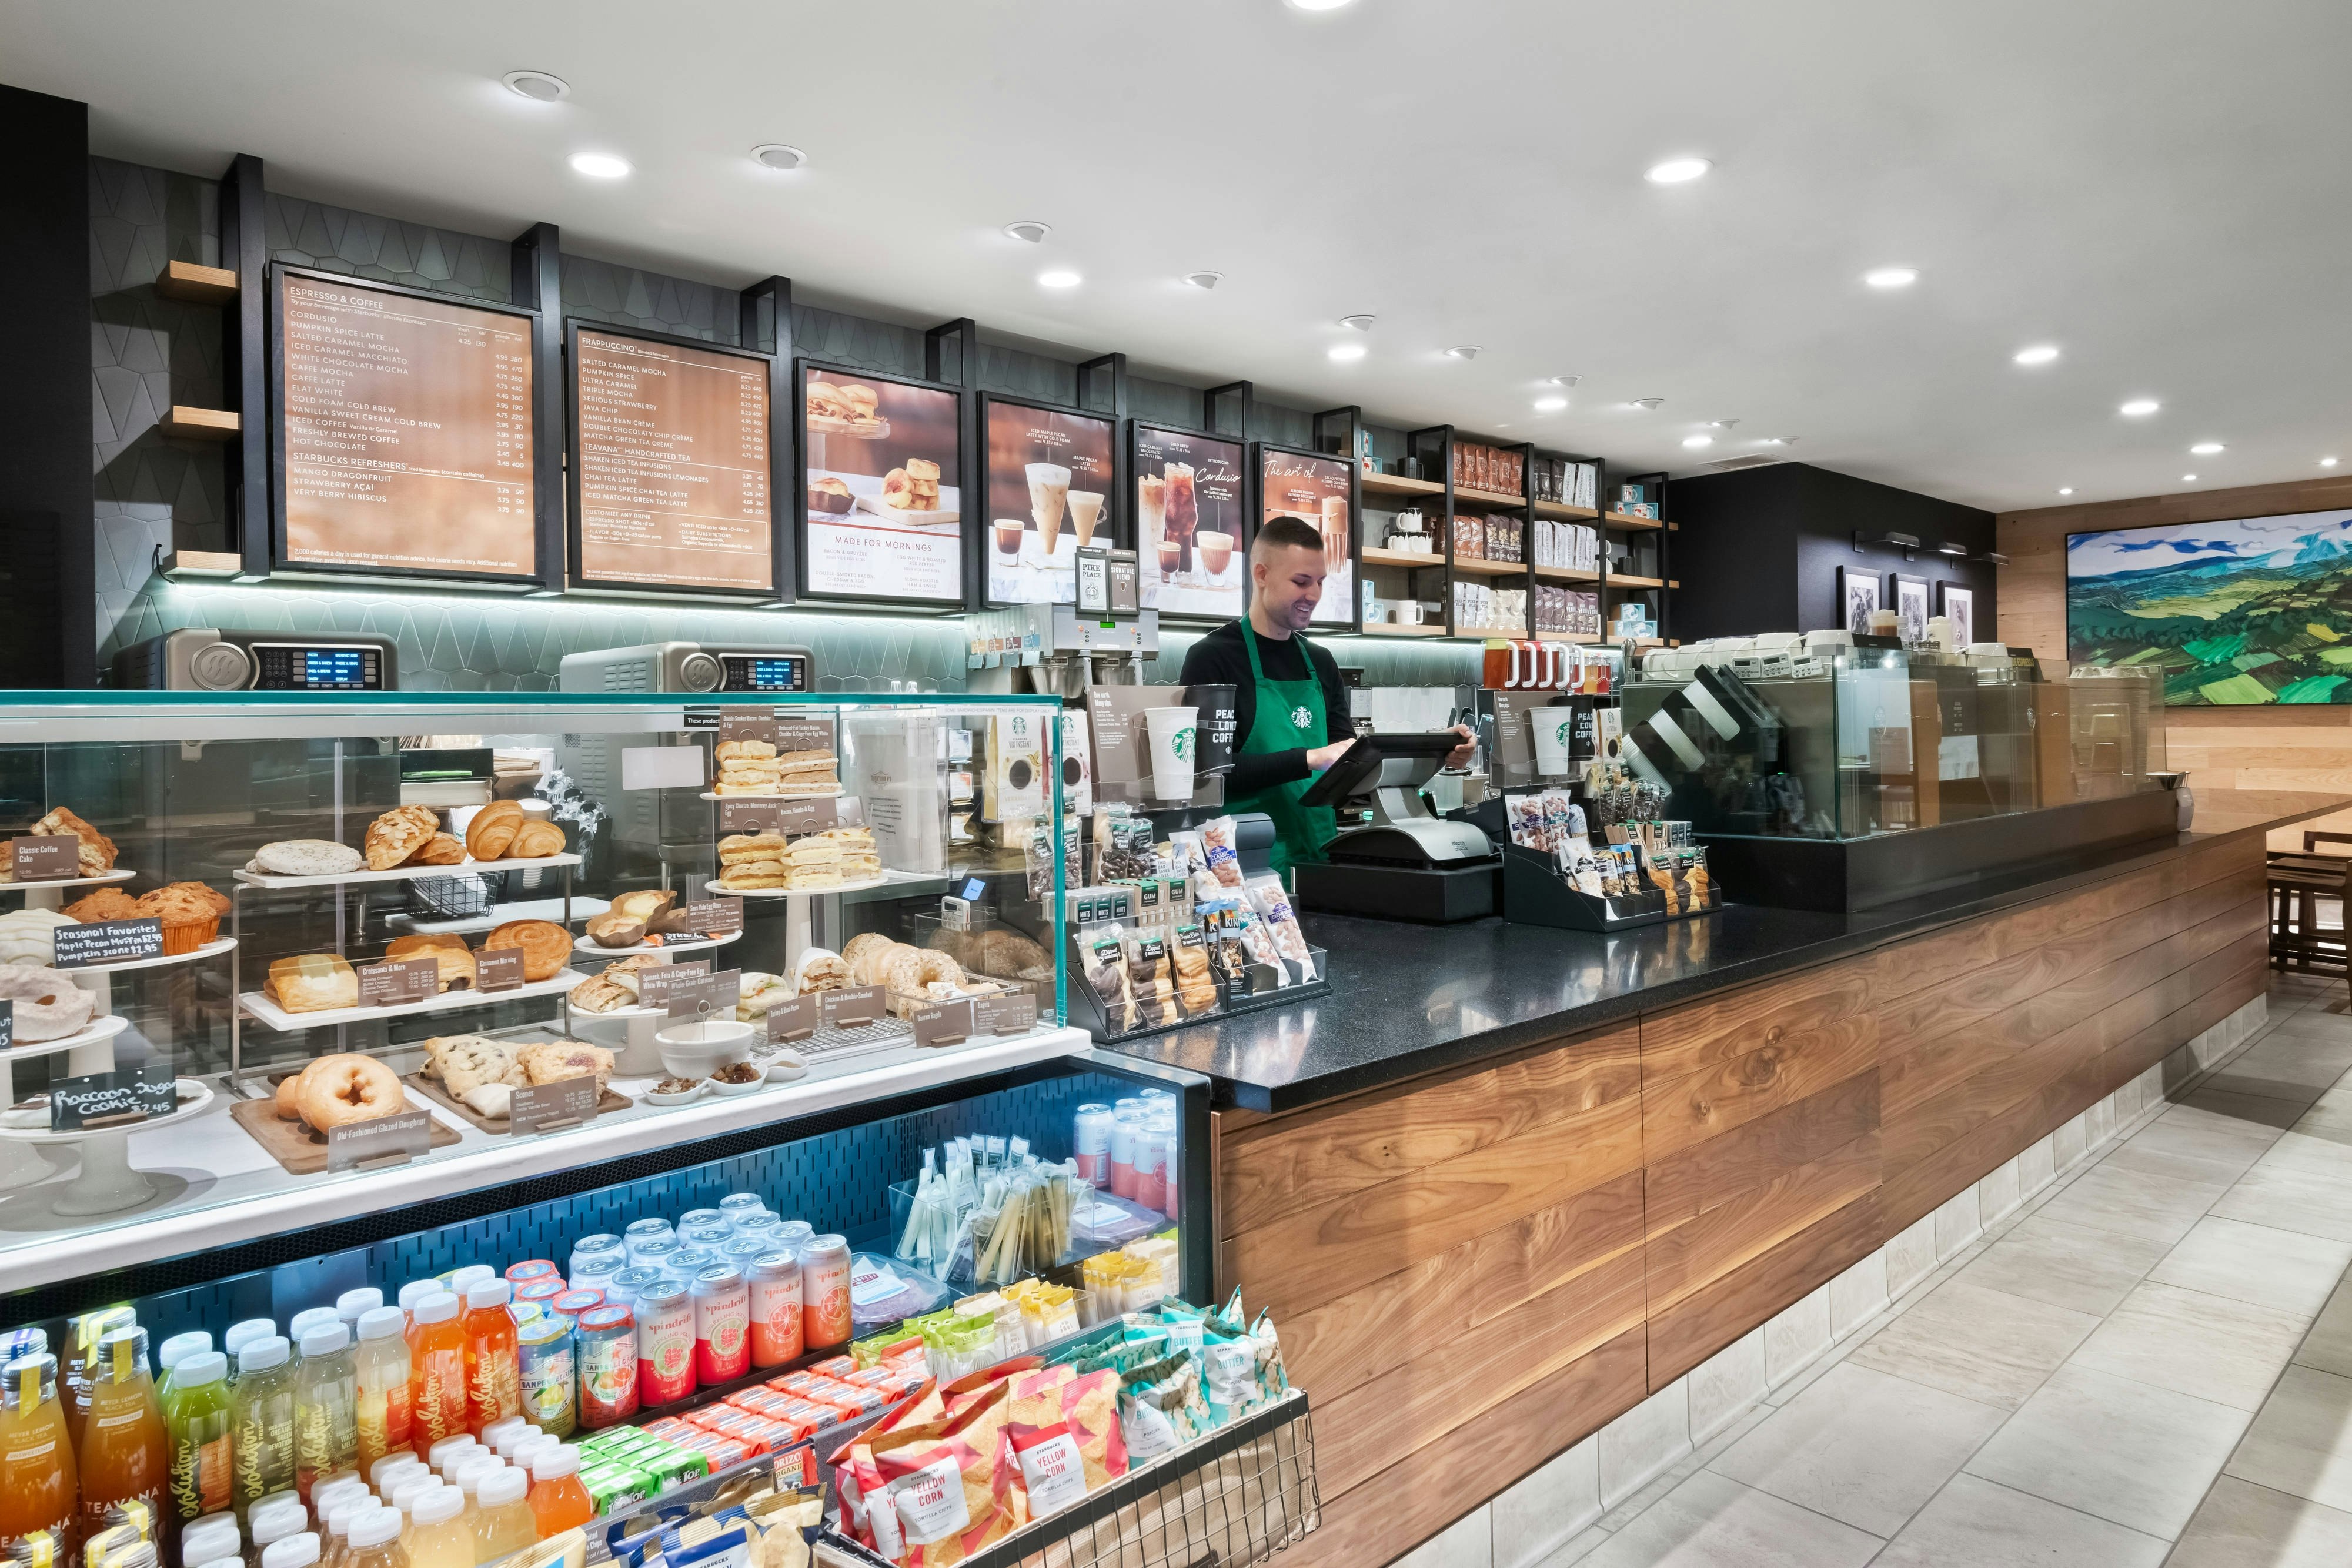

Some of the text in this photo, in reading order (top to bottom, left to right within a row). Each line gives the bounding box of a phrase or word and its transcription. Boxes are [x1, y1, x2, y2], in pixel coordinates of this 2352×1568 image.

[290, 287, 337, 301] ESPRESSO
[350, 297, 383, 309] COFFEE
[290, 310, 336, 323] CORDUSIO
[291, 321, 383, 340] PUMPKIN SPICE LATTE
[582, 337, 636, 352] FRAPPUCCINO
[315, 346, 354, 356] CARAMEL
[359, 352, 407, 364] MACCHIATO
[292, 353, 408, 375] WHITE CHOCOLATE MOCHA
[583, 367, 613, 377] PUMPKIN
[583, 376, 637, 390] ULTRA CARAMEL
[583, 386, 604, 394] TRIPLE
[315, 387, 342, 396] WHITE
[373, 405, 396, 413] BREW
[583, 395, 656, 410] SERIOUS STRAWBERRY
[292, 406, 328, 415] VANILLA
[332, 410, 358, 419] SWEET
[363, 414, 390, 423] CREAM
[583, 414, 611, 422] VANILLA
[316, 419, 346, 427] COFFEE
[293, 427, 399, 444] FRESHLY BREWED COFFEE
[315, 440, 365, 450] CHOCOLATE
[584, 443, 619, 453] TEAVANA
[625, 448, 676, 460] HANDCRAFTED
[294, 453, 405, 470] STARBUCKS REFRESHERS
[294, 467, 392, 482] MANGO DRAGONFRUIT
[1195, 467, 1241, 483] Cordusio
[1264, 460, 1317, 483] The art of
[294, 478, 350, 488] STRAWBERRY
[348, 493, 386, 502] HIBISCUS
[835, 536, 932, 552] MADE FOR MORNINGS
[1015, 740, 1032, 748] INSTANT
[1210, 851, 1230, 860] CLASSIC
[56, 925, 157, 940] Seasonal Favorites
[56, 933, 163, 951] Maple Pecan Muffin $2.45
[56, 950, 101, 961] Pumpkin
[130, 943, 158, 955] $2.95
[479, 956, 517, 967] Cinnamon Morning
[362, 964, 406, 976] Croissants & More
[54, 1081, 177, 1106] Raccoon Sugar
[516, 1090, 534, 1099] Scones
[78, 1096, 142, 1115] Cookie
[337, 1118, 426, 1141] Old-Fashioned Glazed Doughnut
[764, 1279, 801, 1299] spindrift
[705, 1295, 746, 1315] spindrift
[649, 1313, 692, 1335] spindrift
[1175, 1336, 1202, 1347] BUTTER
[1218, 1354, 1244, 1370] BUTTER
[1144, 1427, 1160, 1437] POPCORN
[9, 1443, 53, 1459] UNSWEETENED
[1036, 1442, 1061, 1455] STARBUCKS
[1037, 1447, 1067, 1469] YELLOW
[910, 1467, 940, 1482] STARBUCKS
[1045, 1462, 1066, 1479] CORN
[910, 1473, 946, 1495] YELLOW
[1041, 1477, 1073, 1493] TORTILLA CHIPS
[918, 1489, 944, 1507] CORN
[914, 1504, 952, 1523] TORTILLA CHIPS
